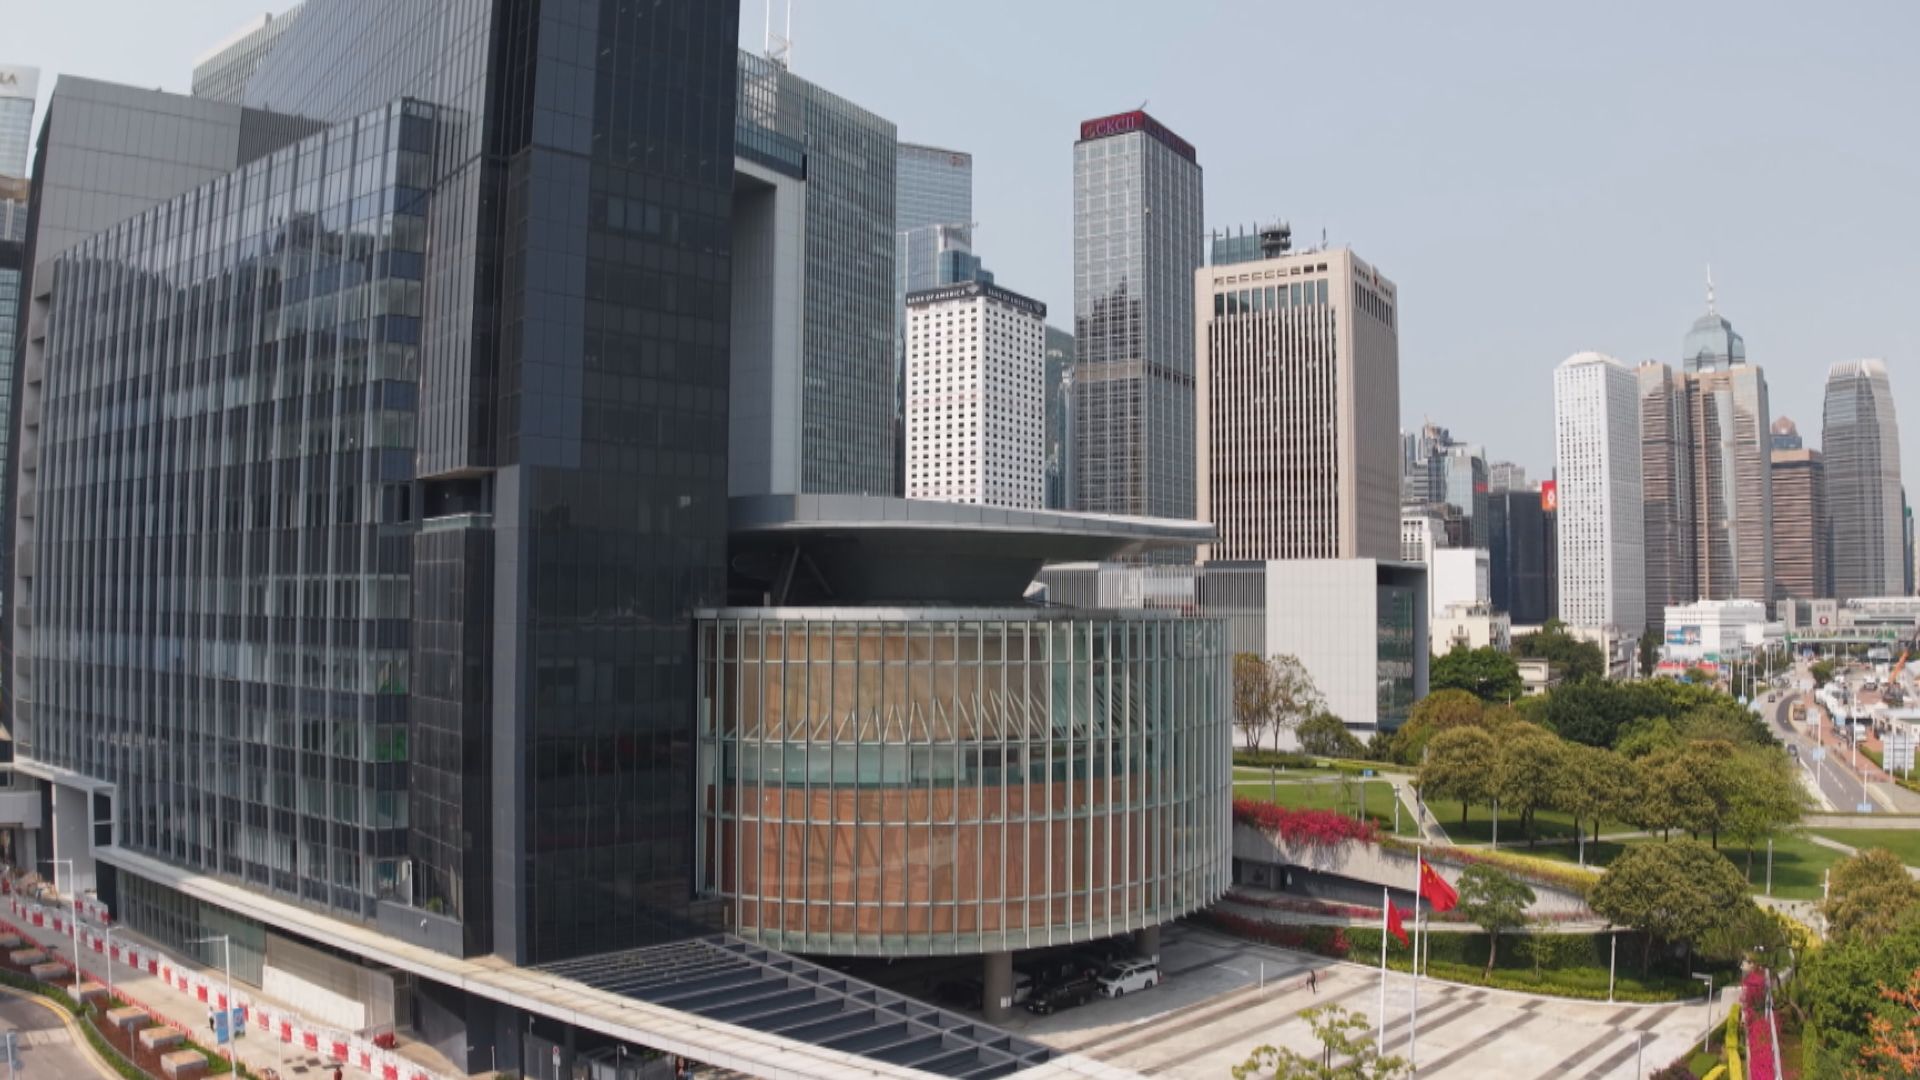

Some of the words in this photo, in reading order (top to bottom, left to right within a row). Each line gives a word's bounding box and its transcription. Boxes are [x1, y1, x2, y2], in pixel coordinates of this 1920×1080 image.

[907, 295, 924, 305] BANK
[926, 294, 935, 302] OF
[935, 287, 965, 300] AMERICA
